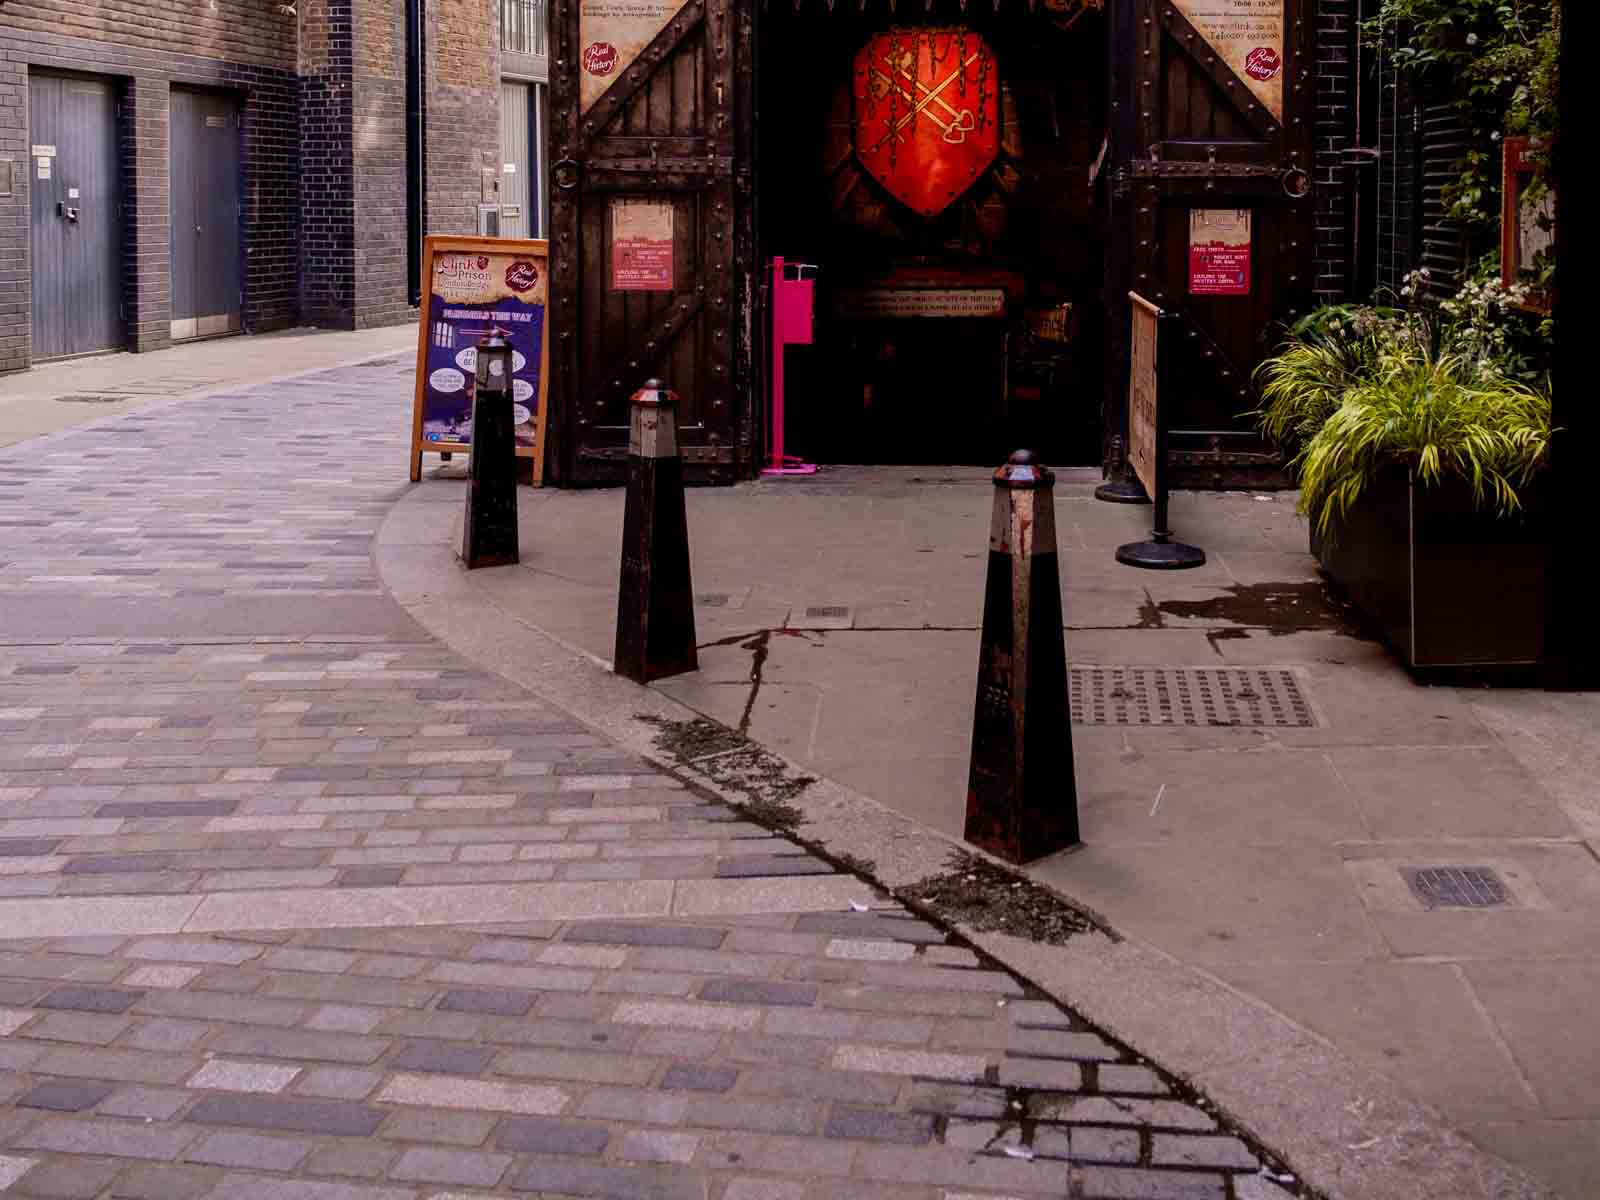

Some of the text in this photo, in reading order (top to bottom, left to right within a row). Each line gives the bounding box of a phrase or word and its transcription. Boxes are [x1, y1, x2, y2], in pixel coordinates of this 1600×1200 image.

[590, 44, 609, 58] Real
[1255, 48, 1277, 63] Real
[586, 55, 617, 73] History!
[1244, 58, 1280, 79] History!
[441, 256, 475, 269] Clink
[458, 270, 492, 281] Prison
[511, 312, 534, 322] WAY
